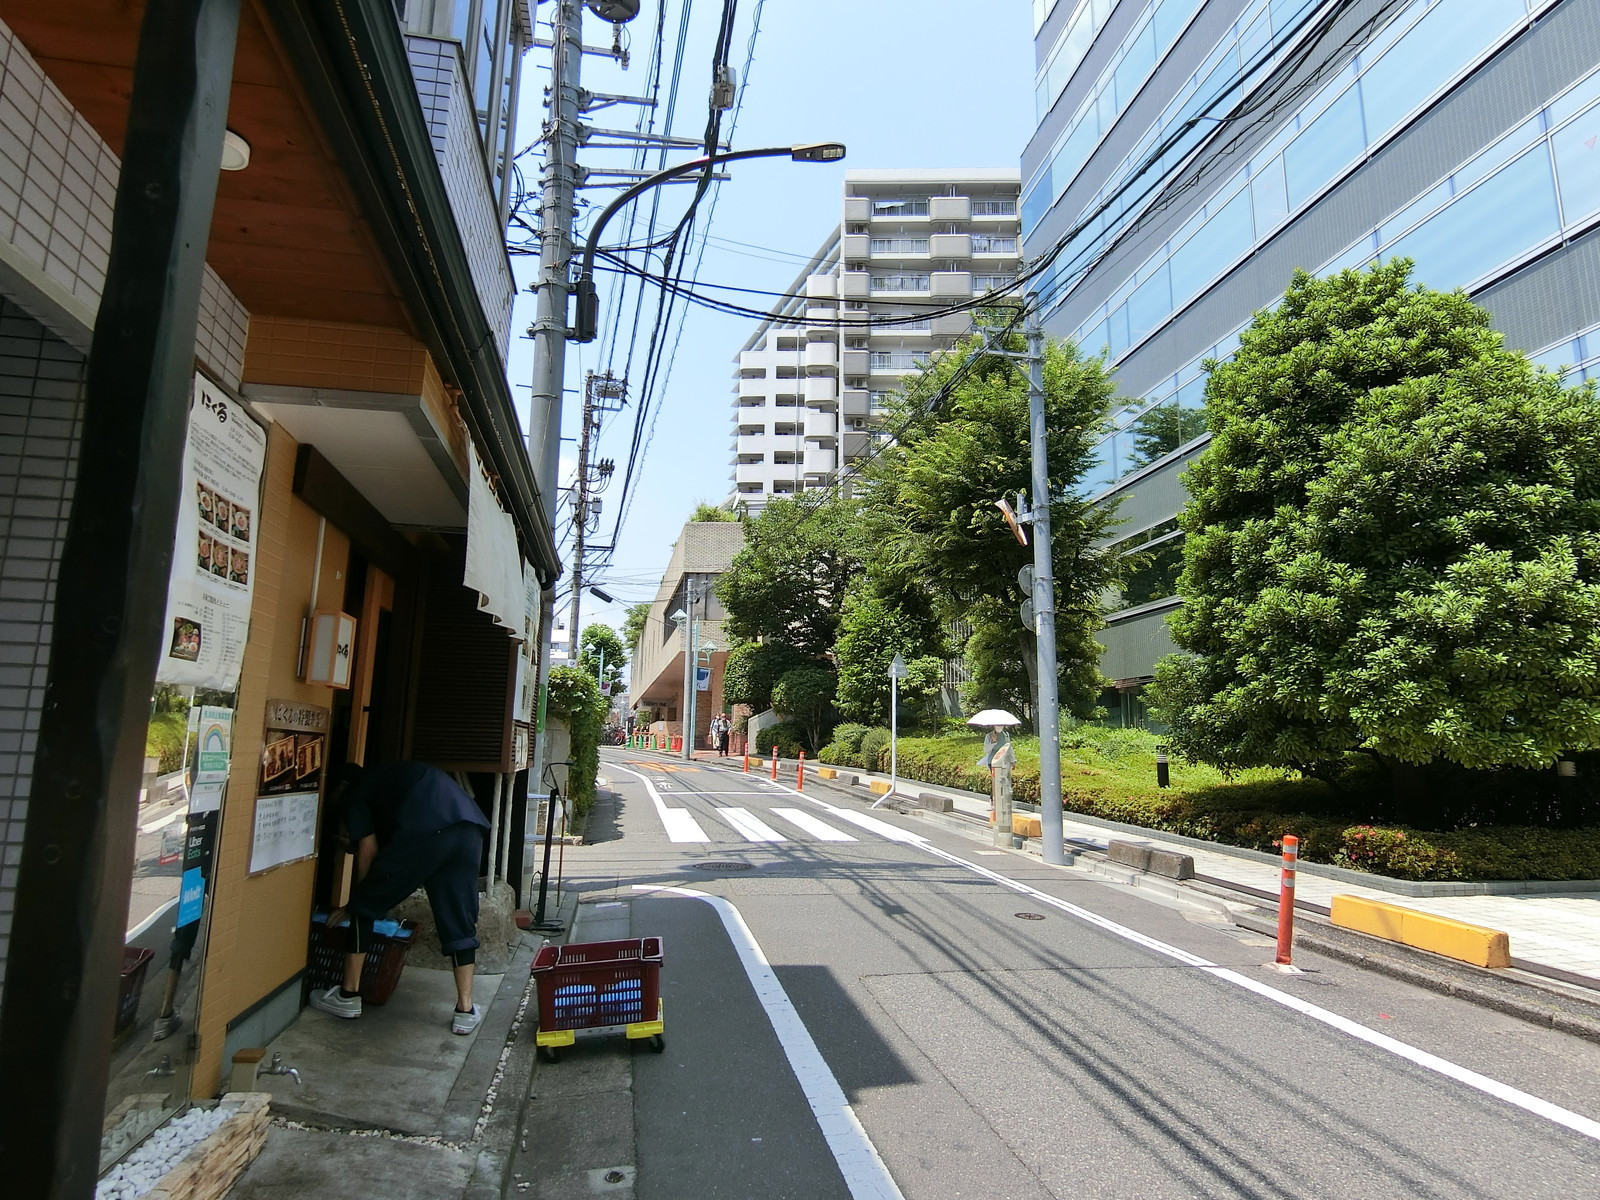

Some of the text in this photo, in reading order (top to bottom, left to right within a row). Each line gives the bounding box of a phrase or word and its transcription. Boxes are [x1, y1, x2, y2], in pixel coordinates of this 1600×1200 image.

[201, 389, 228, 424] にくる
[188, 836, 203, 848] Uber
[187, 848, 202, 860] Eats
